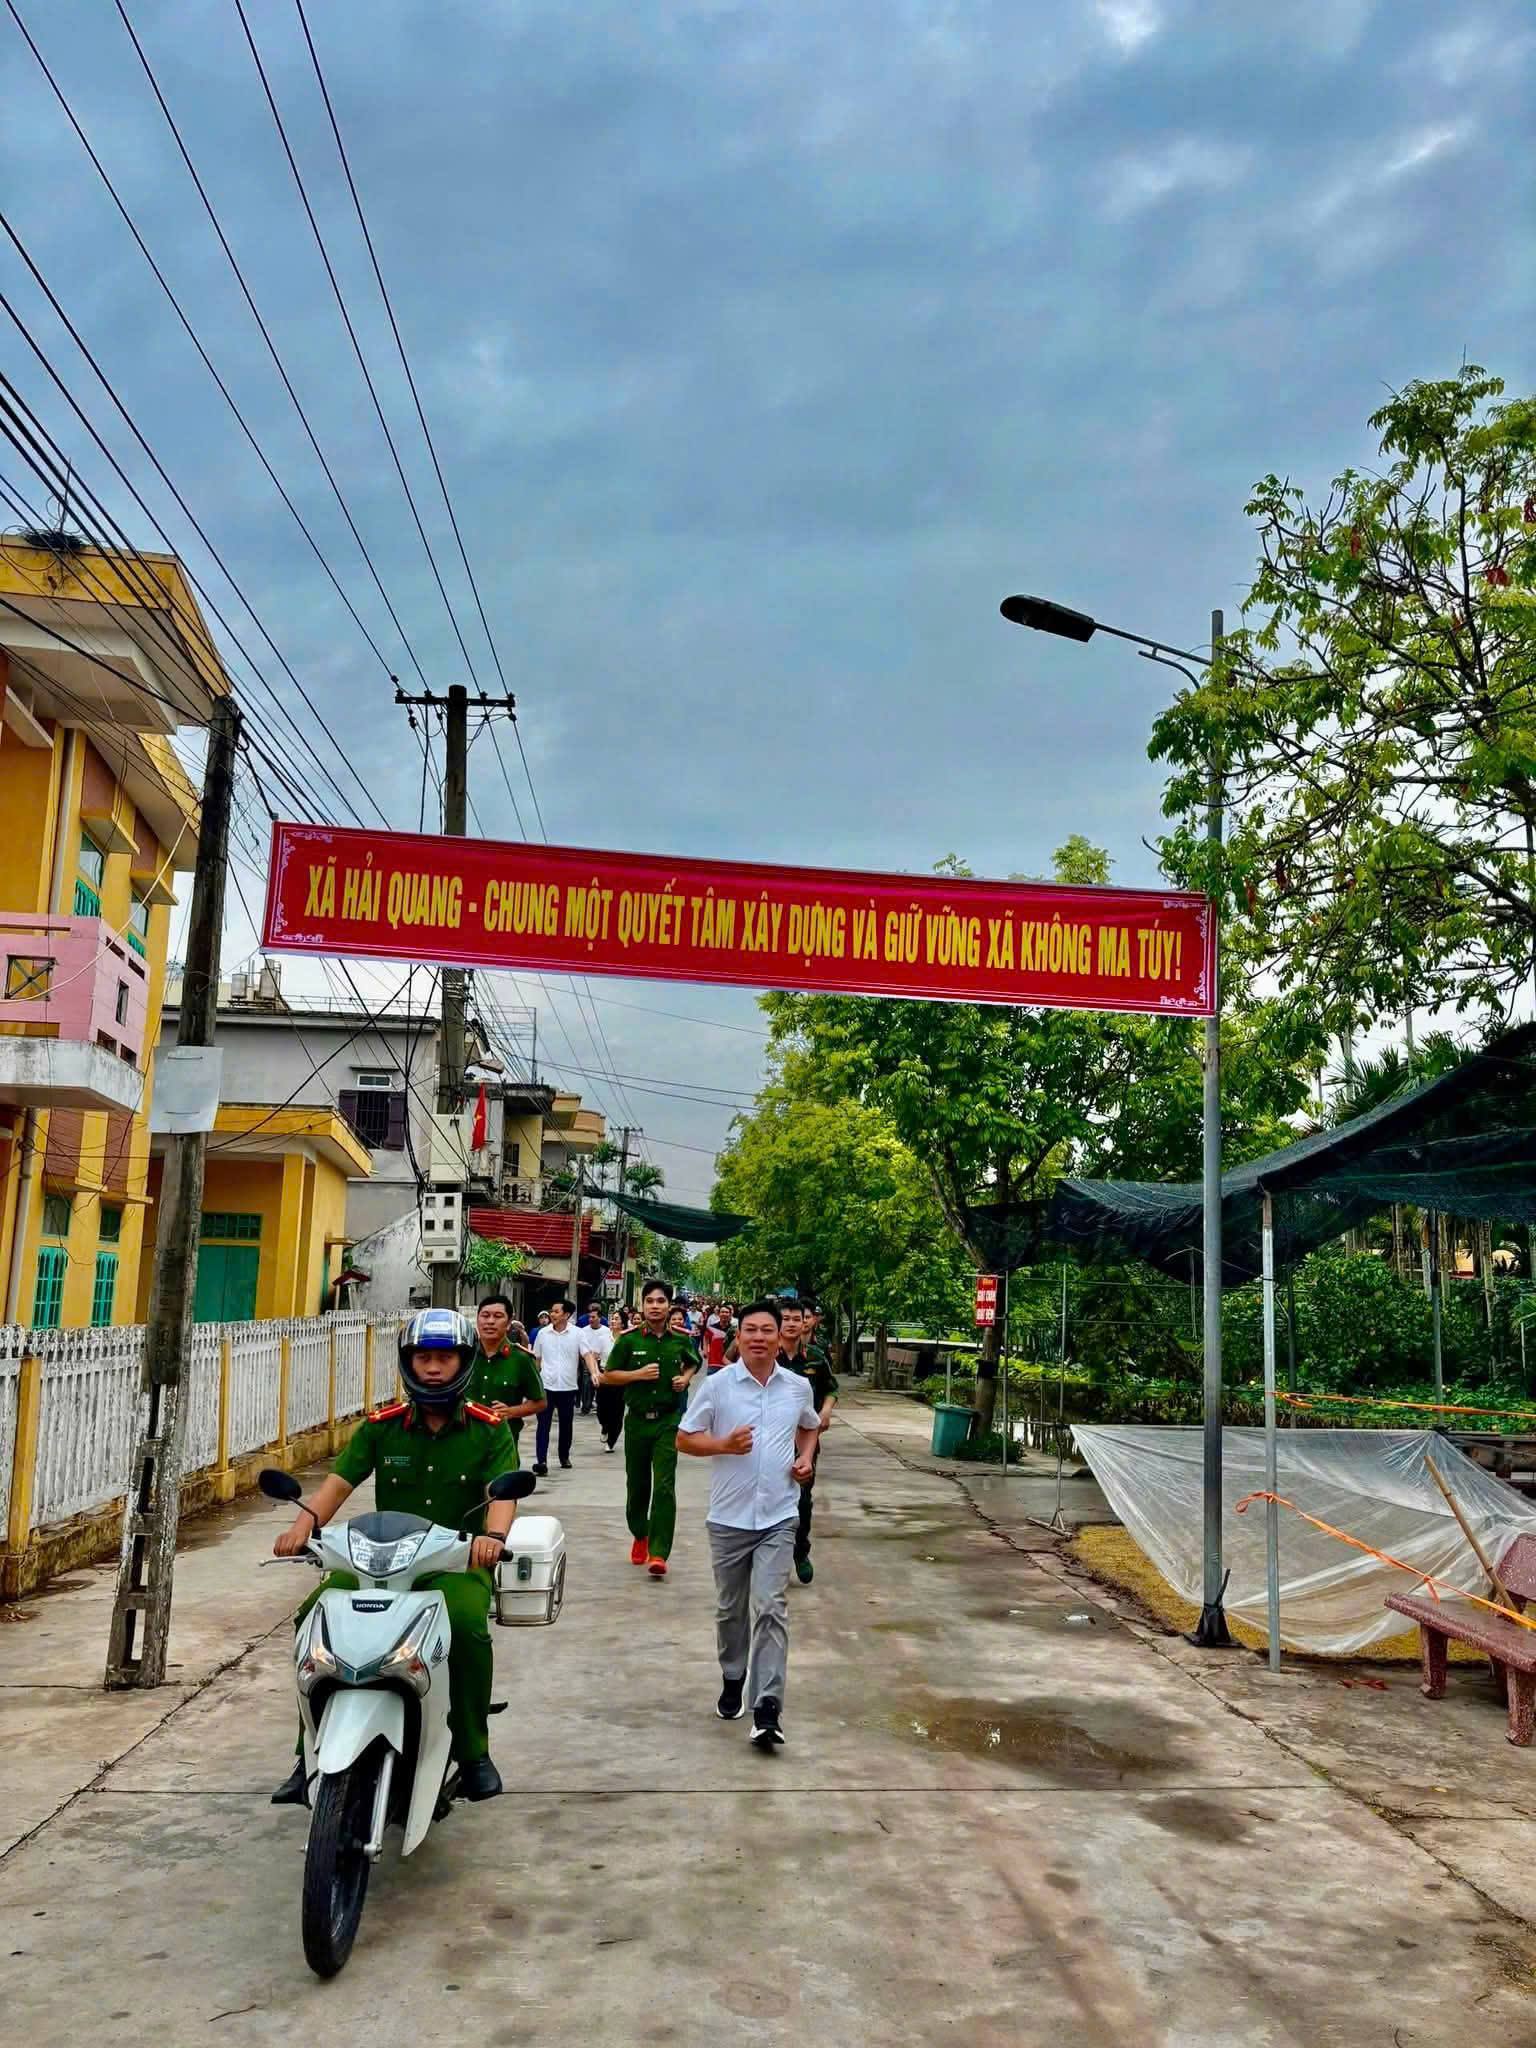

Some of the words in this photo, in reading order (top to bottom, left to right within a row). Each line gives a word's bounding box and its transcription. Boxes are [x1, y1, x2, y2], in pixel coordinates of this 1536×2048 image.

[305, 856, 337, 918] XÃ
[342, 852, 382, 922] HẢI
[387, 872, 463, 930] QUANG
[468, 902, 477, 913] -
[484, 880, 560, 936] CHUNG
[564, 879, 614, 951] MỘT
[618, 878, 685, 949] QUYẾT
[689, 887, 736, 950] TÂM
[740, 891, 783, 953] XÂY
[788, 902, 846, 967] DỰNG
[853, 899, 878, 960] VÀ
[884, 907, 923, 963] GIỮ
[926, 906, 981, 968] VỮNG
[986, 910, 1014, 971] XÃ
[1020, 912, 1092, 975] KHÔNG
[1097, 927, 1131, 978] MA
[1137, 919, 1182, 981] TÚY!
